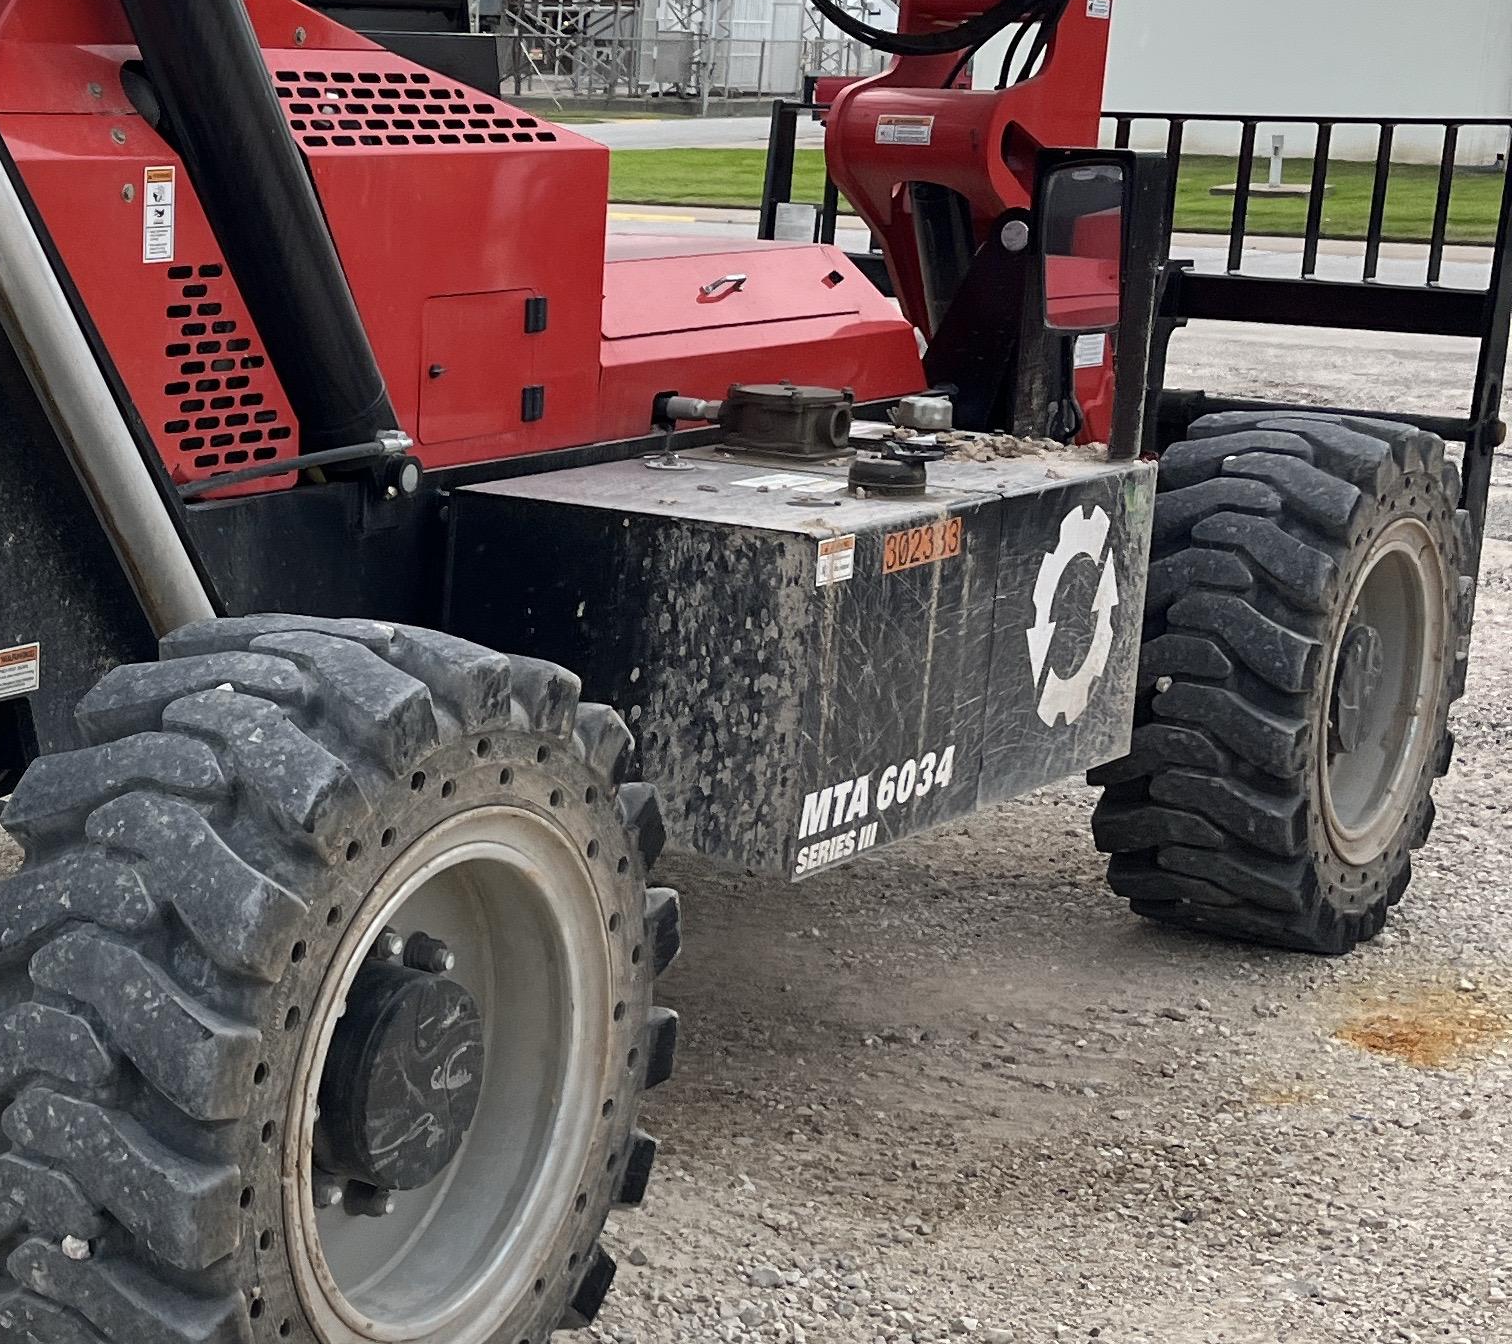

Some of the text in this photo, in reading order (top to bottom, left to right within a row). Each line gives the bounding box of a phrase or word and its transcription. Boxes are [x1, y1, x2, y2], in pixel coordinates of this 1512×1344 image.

[797, 744, 956, 841] MTA 6034
[794, 821, 879, 875] SERIES III
